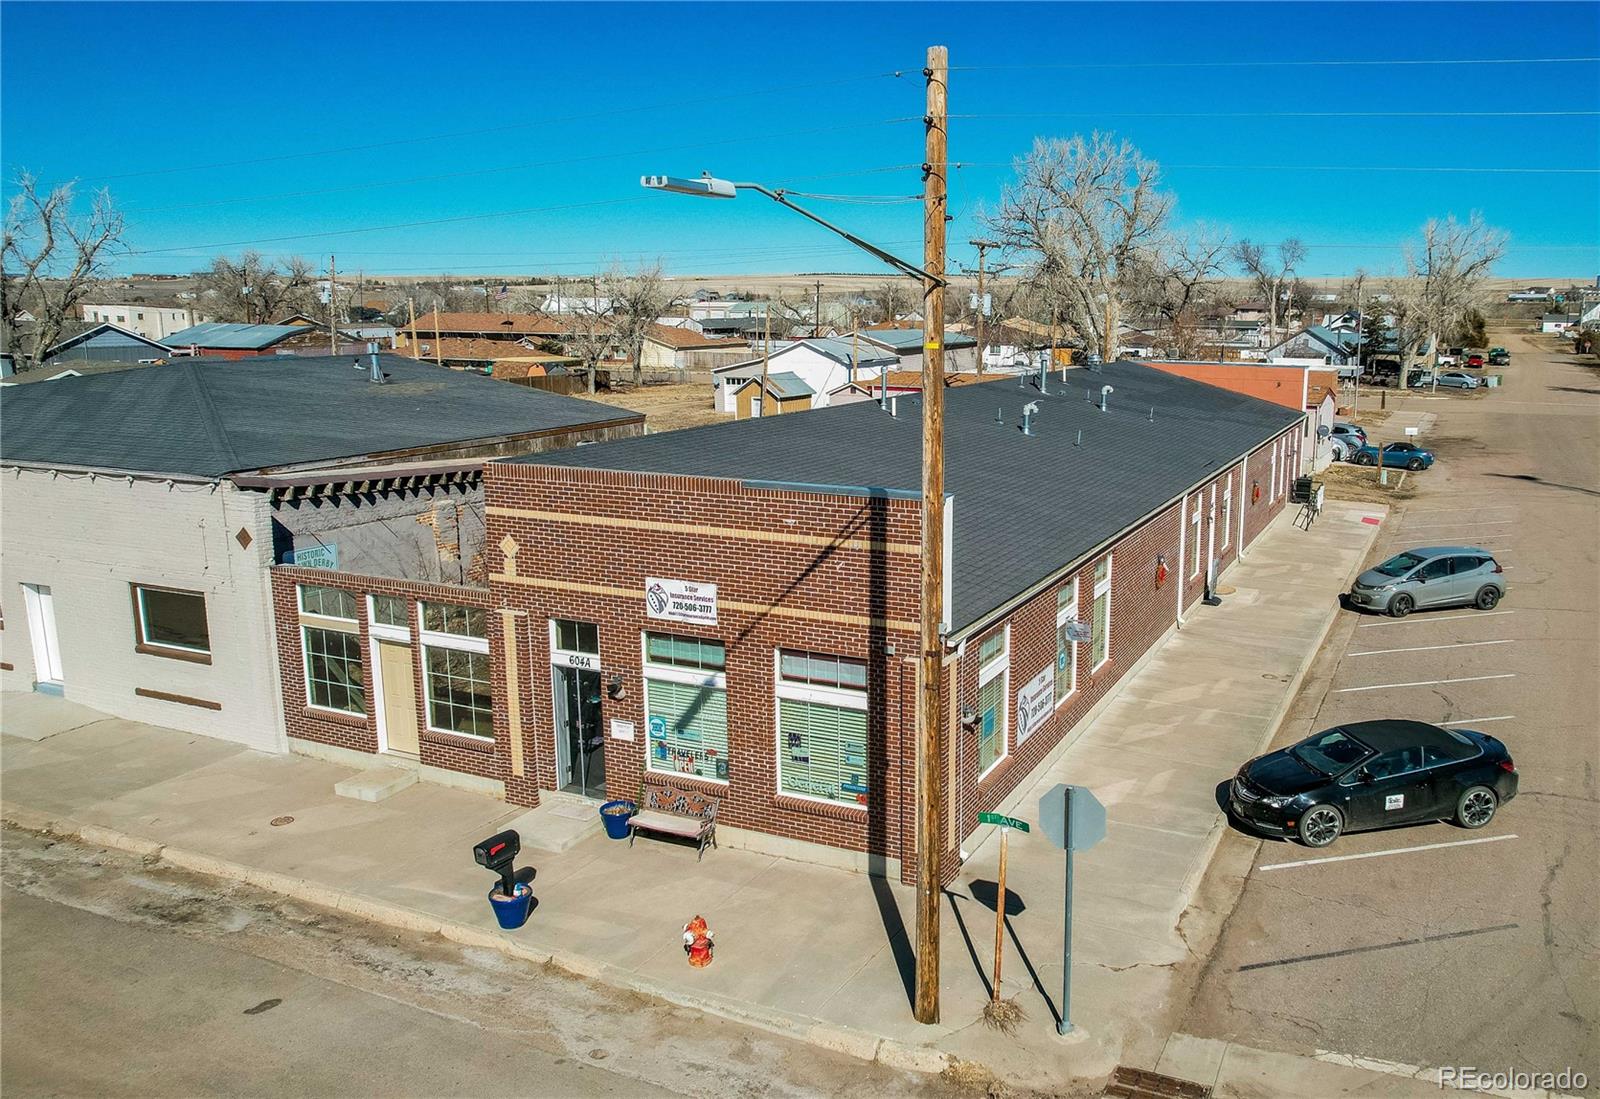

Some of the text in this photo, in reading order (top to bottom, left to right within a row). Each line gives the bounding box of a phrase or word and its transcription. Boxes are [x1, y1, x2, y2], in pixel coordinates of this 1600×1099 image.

[297, 548, 325, 561] HISTORIC
[314, 558, 335, 568] DERBY
[669, 592, 714, 603] Insurance Services
[569, 655, 591, 668] 604A
[1000, 816, 1023, 829] AVE
